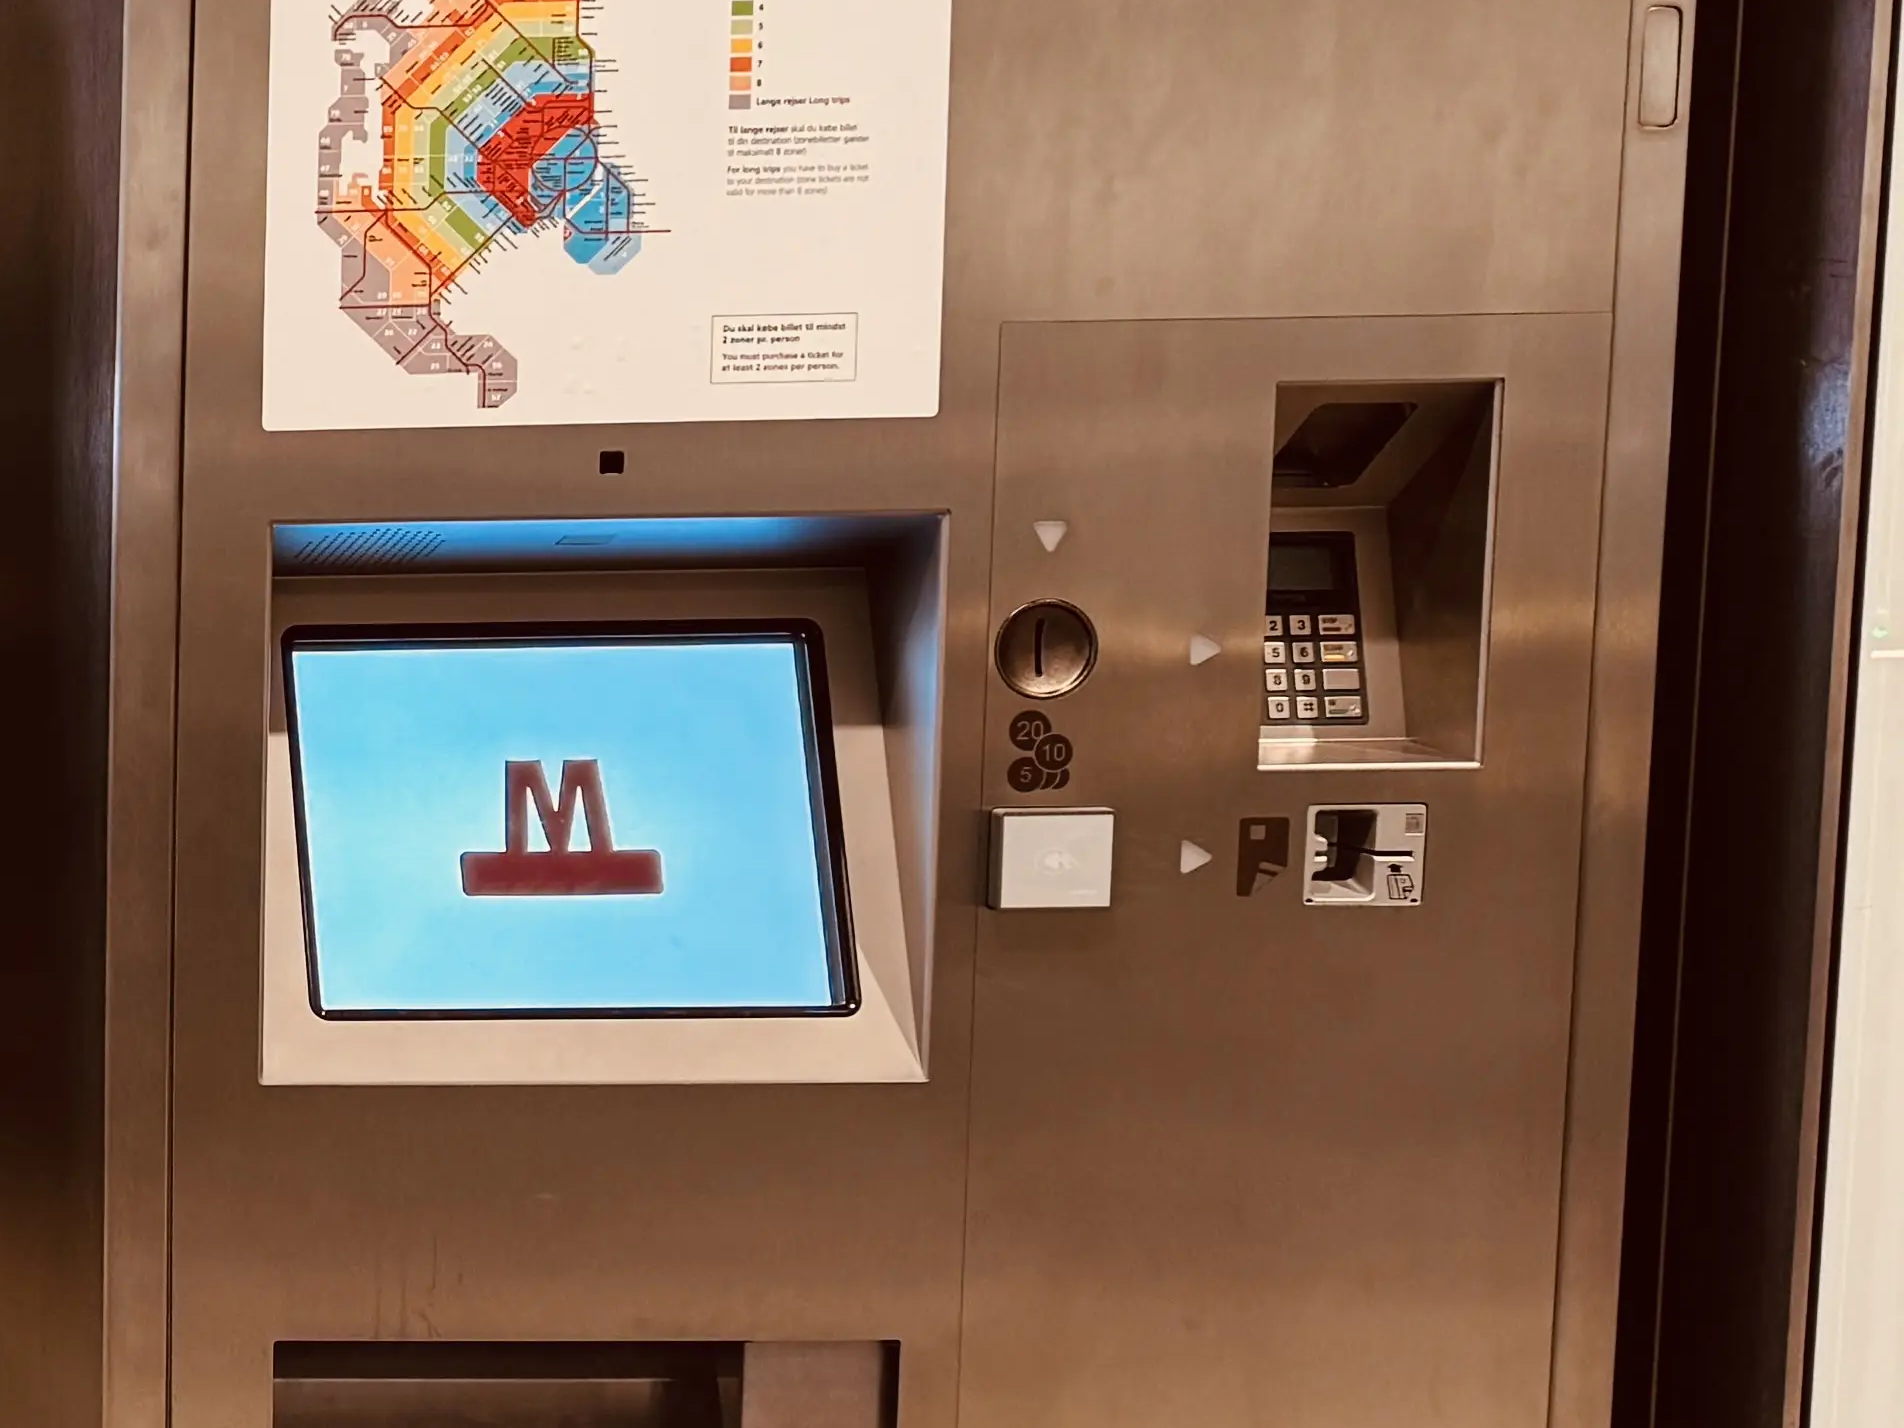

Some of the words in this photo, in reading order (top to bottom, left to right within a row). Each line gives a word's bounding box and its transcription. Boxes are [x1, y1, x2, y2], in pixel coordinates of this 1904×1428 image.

[1268, 620, 1278, 631] 2
[1297, 620, 1307, 631] 3
[1271, 648, 1281, 658] 5
[1299, 648, 1309, 658] 6
[1016, 721, 1044, 740] 20
[1042, 744, 1065, 761] 10
[1020, 767, 1032, 782] 5
